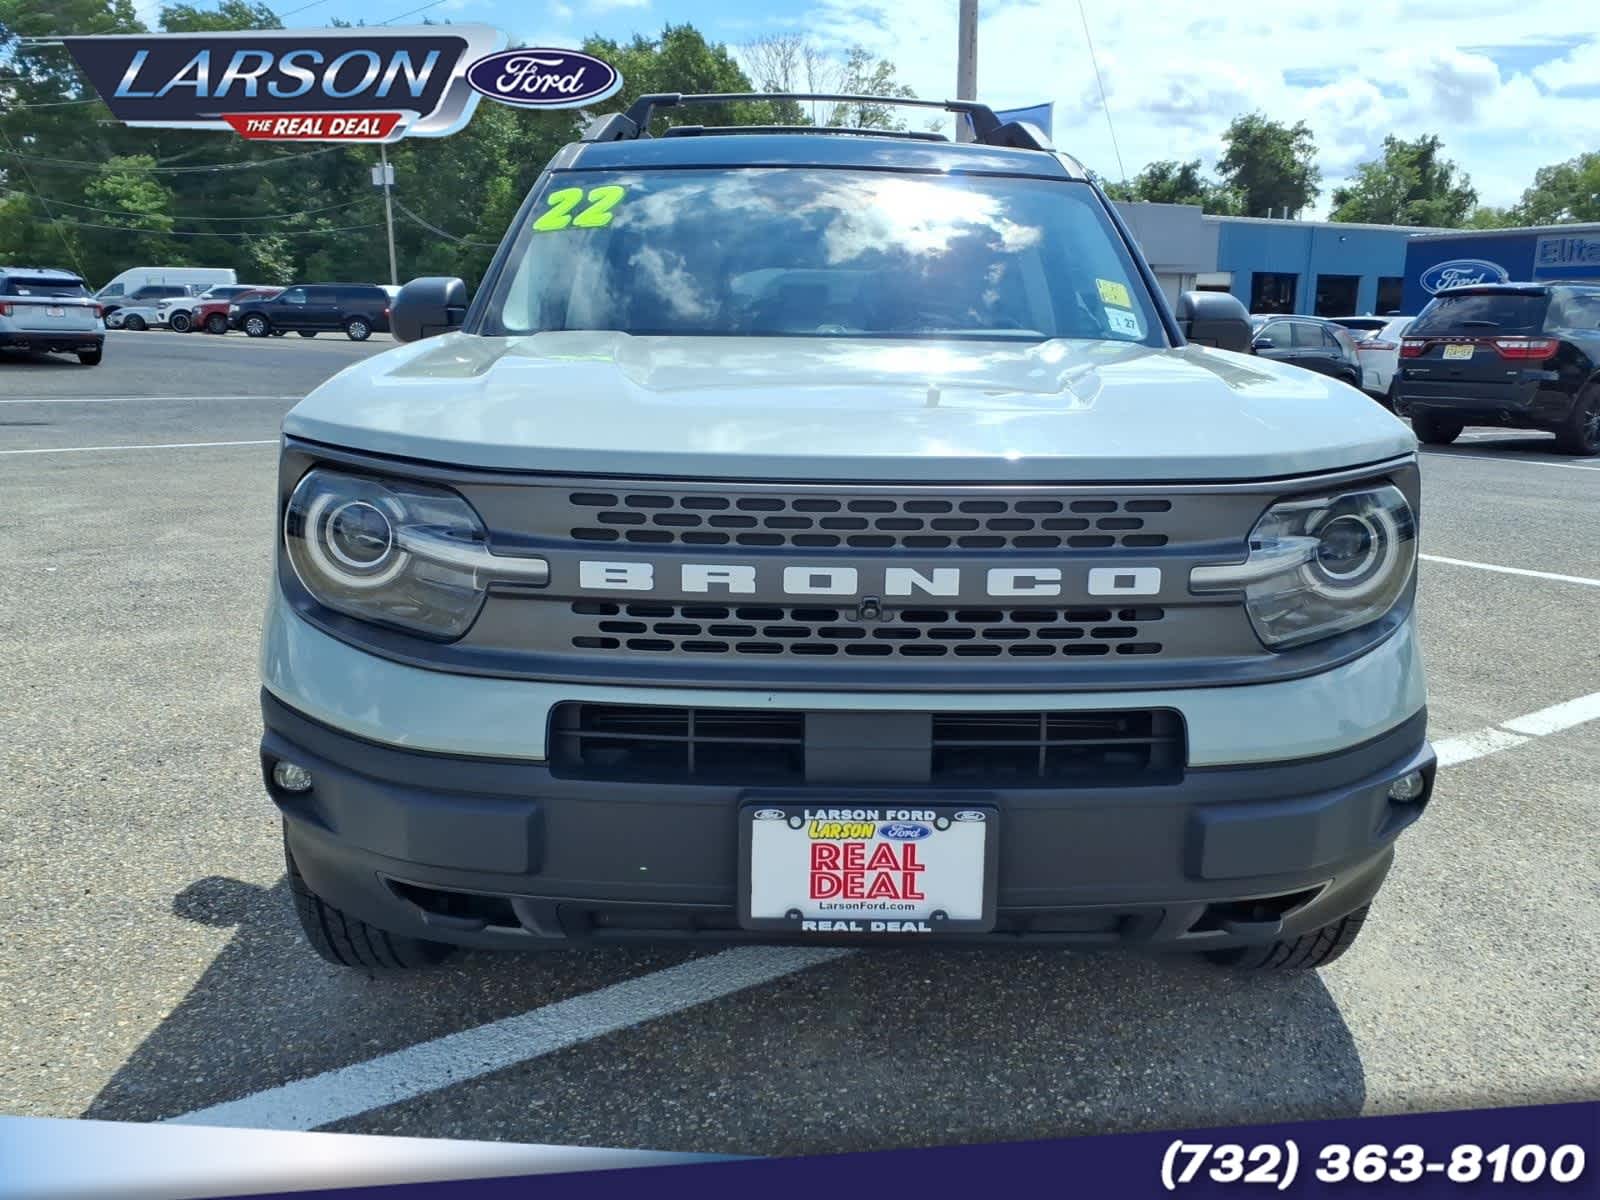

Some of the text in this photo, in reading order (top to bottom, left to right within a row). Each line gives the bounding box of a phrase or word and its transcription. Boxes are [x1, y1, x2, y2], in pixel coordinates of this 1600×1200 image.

[532, 185, 625, 231] 22
[1435, 268, 1487, 290] Ford
[579, 560, 1162, 597] BRONCO
[804, 809, 936, 822] LARSON FORD
[808, 820, 876, 840] LARSON
[887, 823, 922, 839] Ford
[810, 843, 926, 871] REAL
[810, 871, 925, 900] DEAL
[819, 902, 916, 911] LarsonFord.com
[802, 920, 932, 932] REAL DEAL
